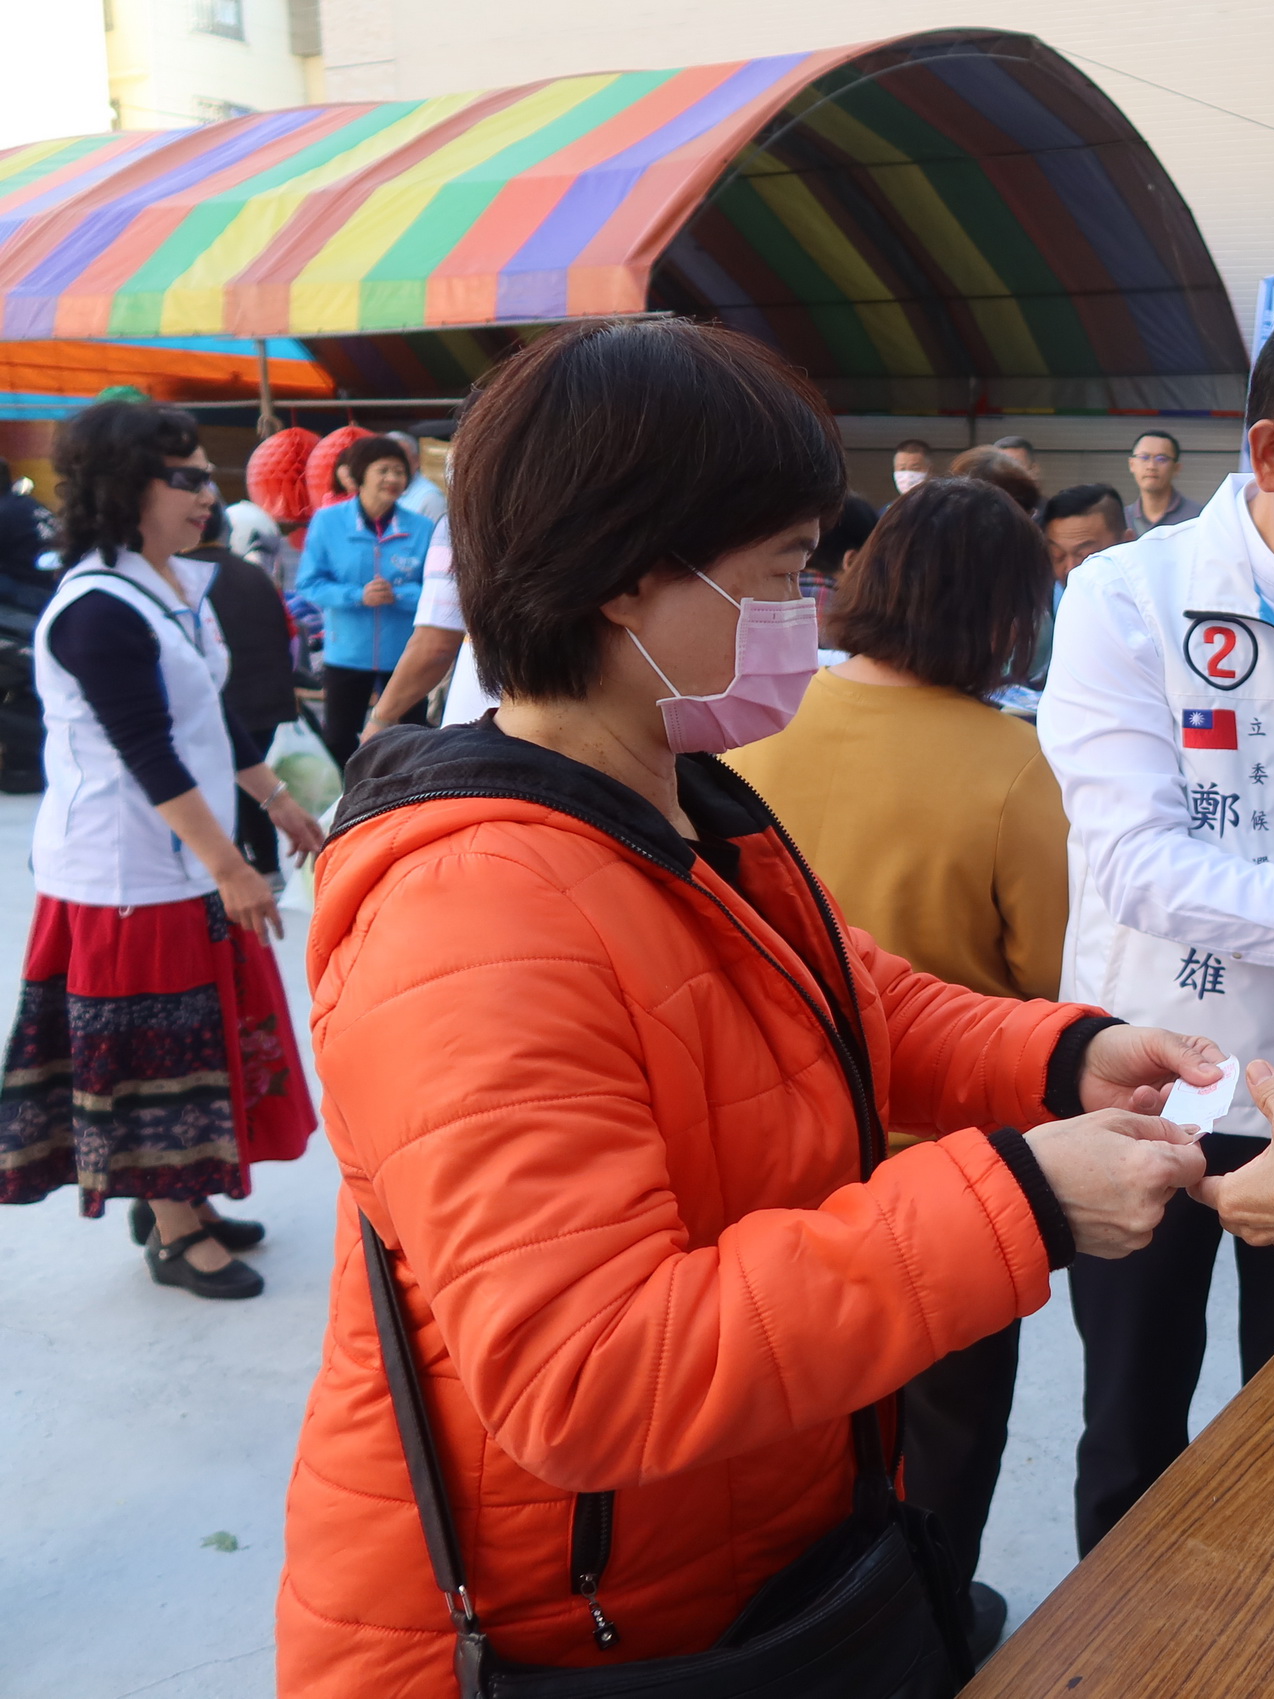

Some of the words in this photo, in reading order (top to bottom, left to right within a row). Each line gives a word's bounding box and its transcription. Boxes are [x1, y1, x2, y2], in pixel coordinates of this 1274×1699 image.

[1203, 626, 1237, 679] 2
[1248, 717, 1270, 866] 立委候
